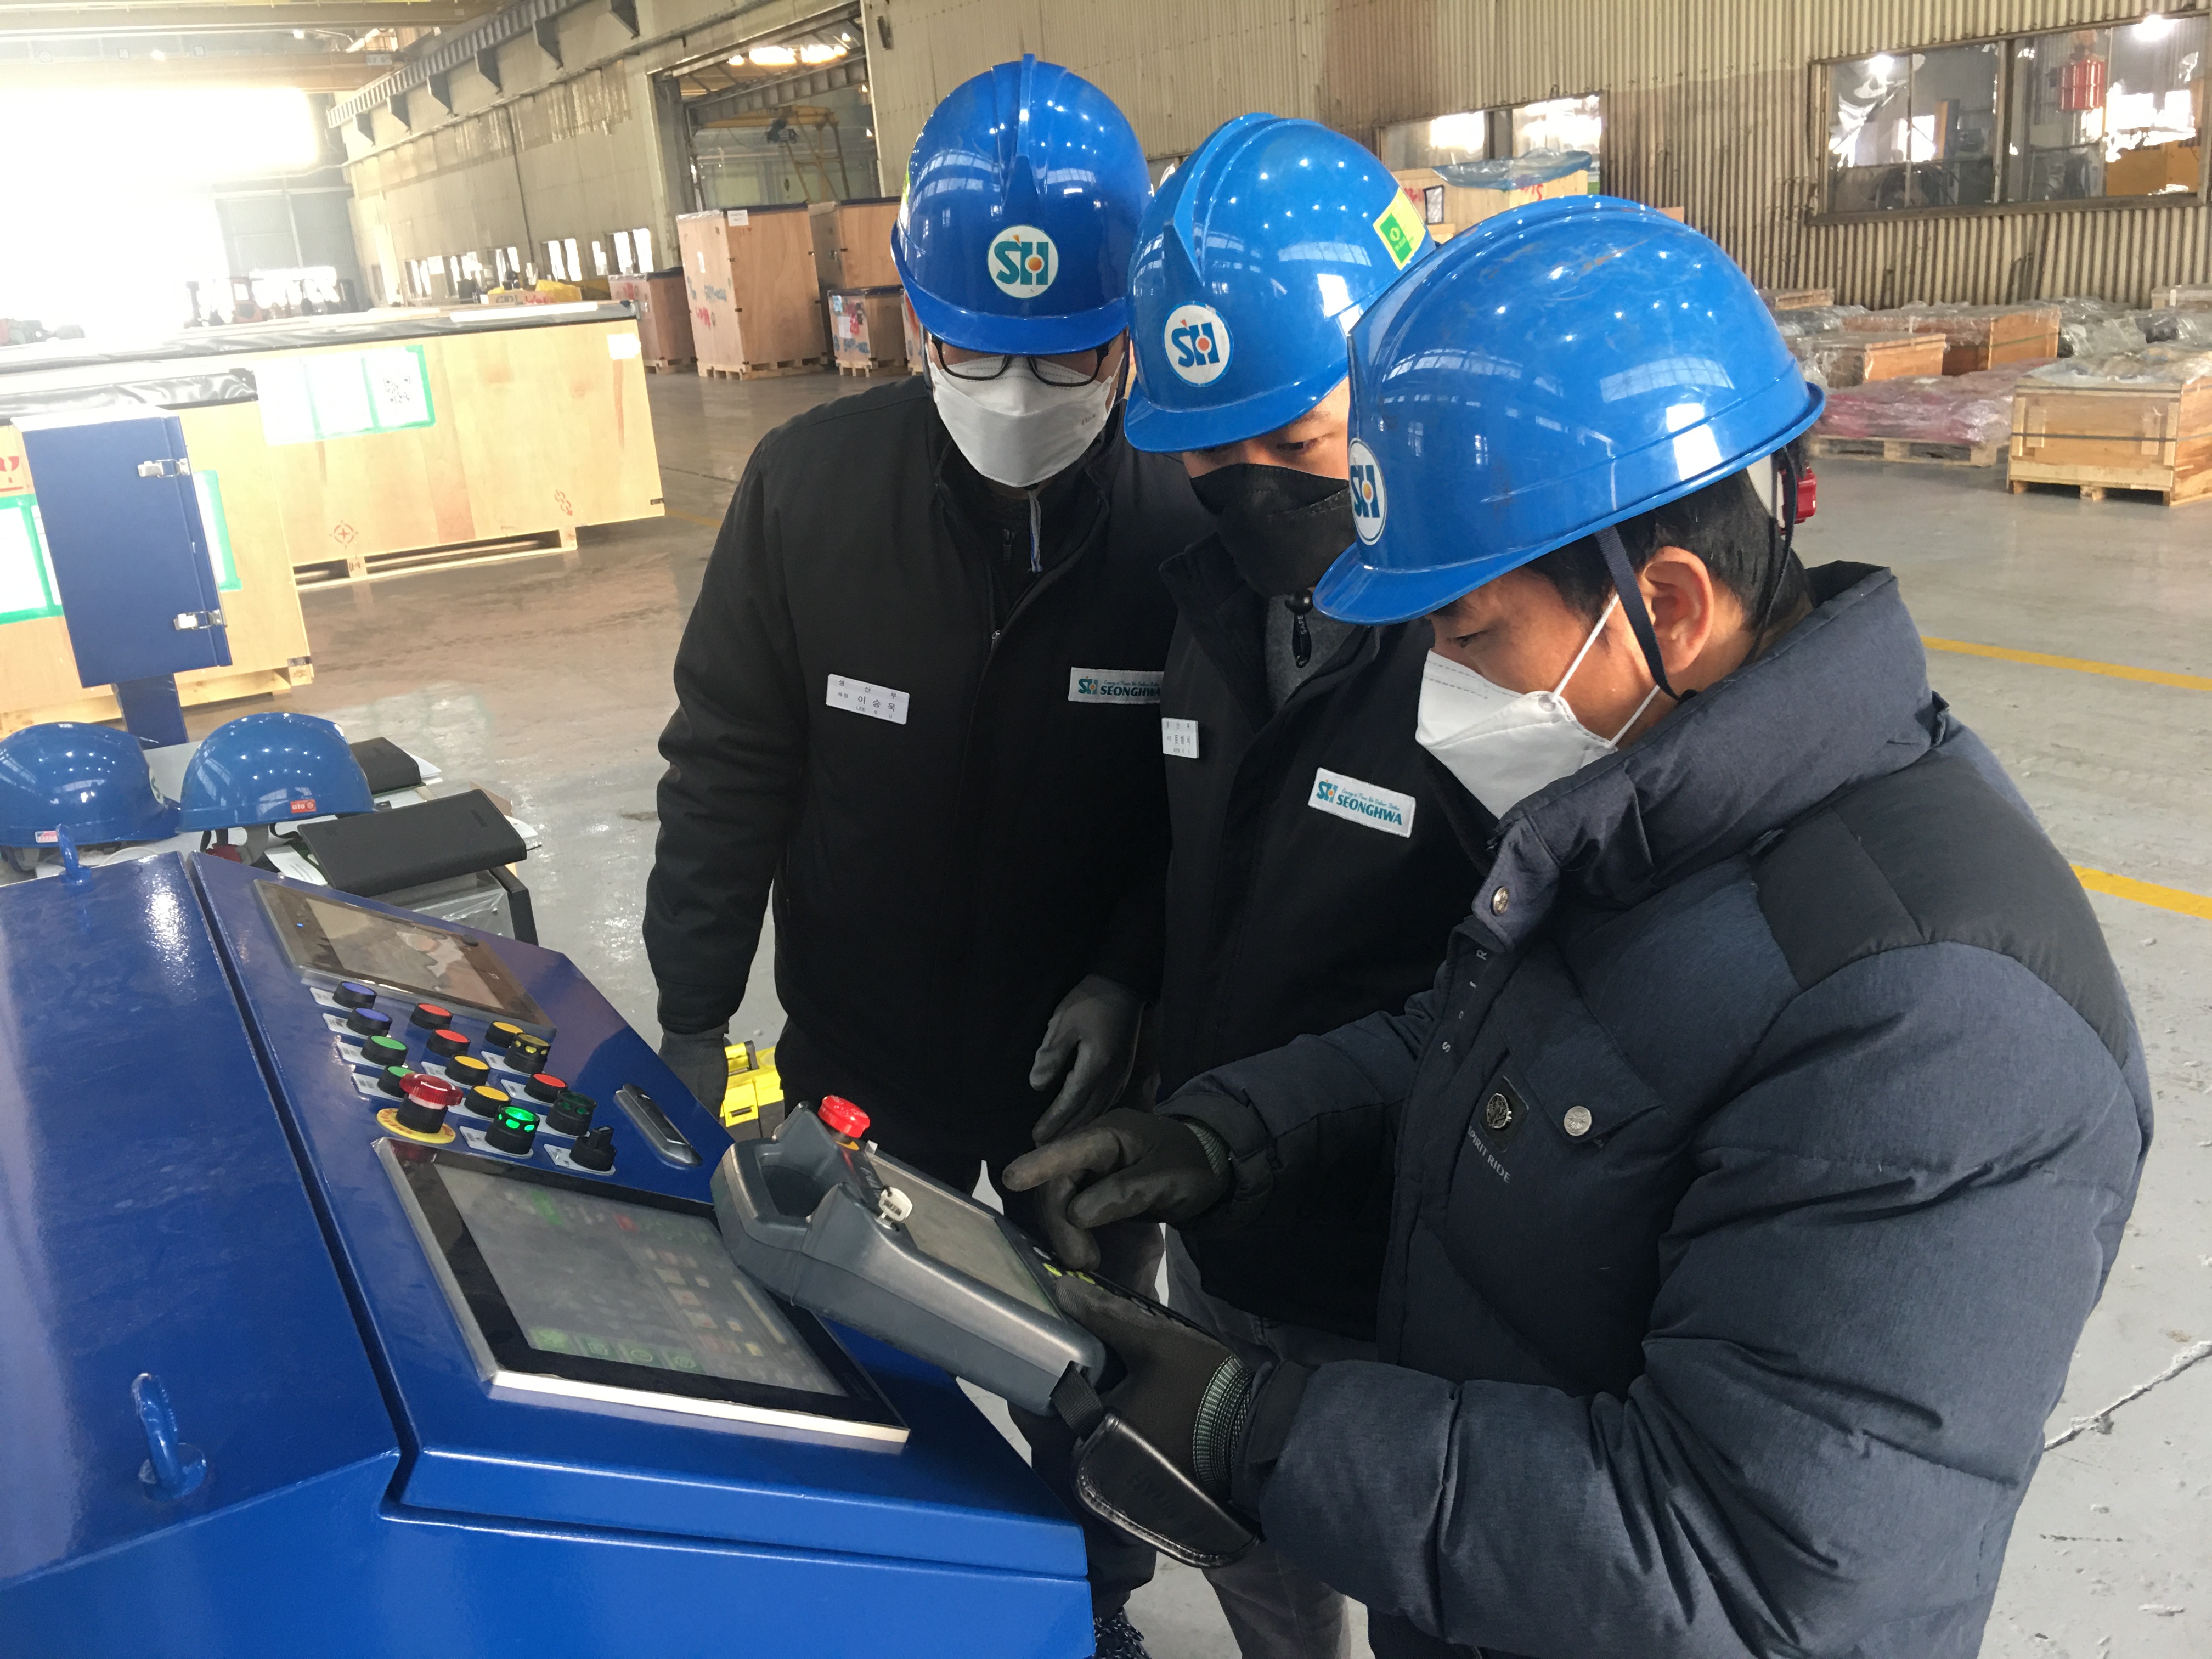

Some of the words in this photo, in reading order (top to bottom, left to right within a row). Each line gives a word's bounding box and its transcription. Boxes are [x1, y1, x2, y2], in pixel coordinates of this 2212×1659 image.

[1336, 794, 1402, 825] SEONGHWA
[1468, 1125, 1488, 1156] SPIRIT
[1487, 1154, 1511, 1184] RIDE
